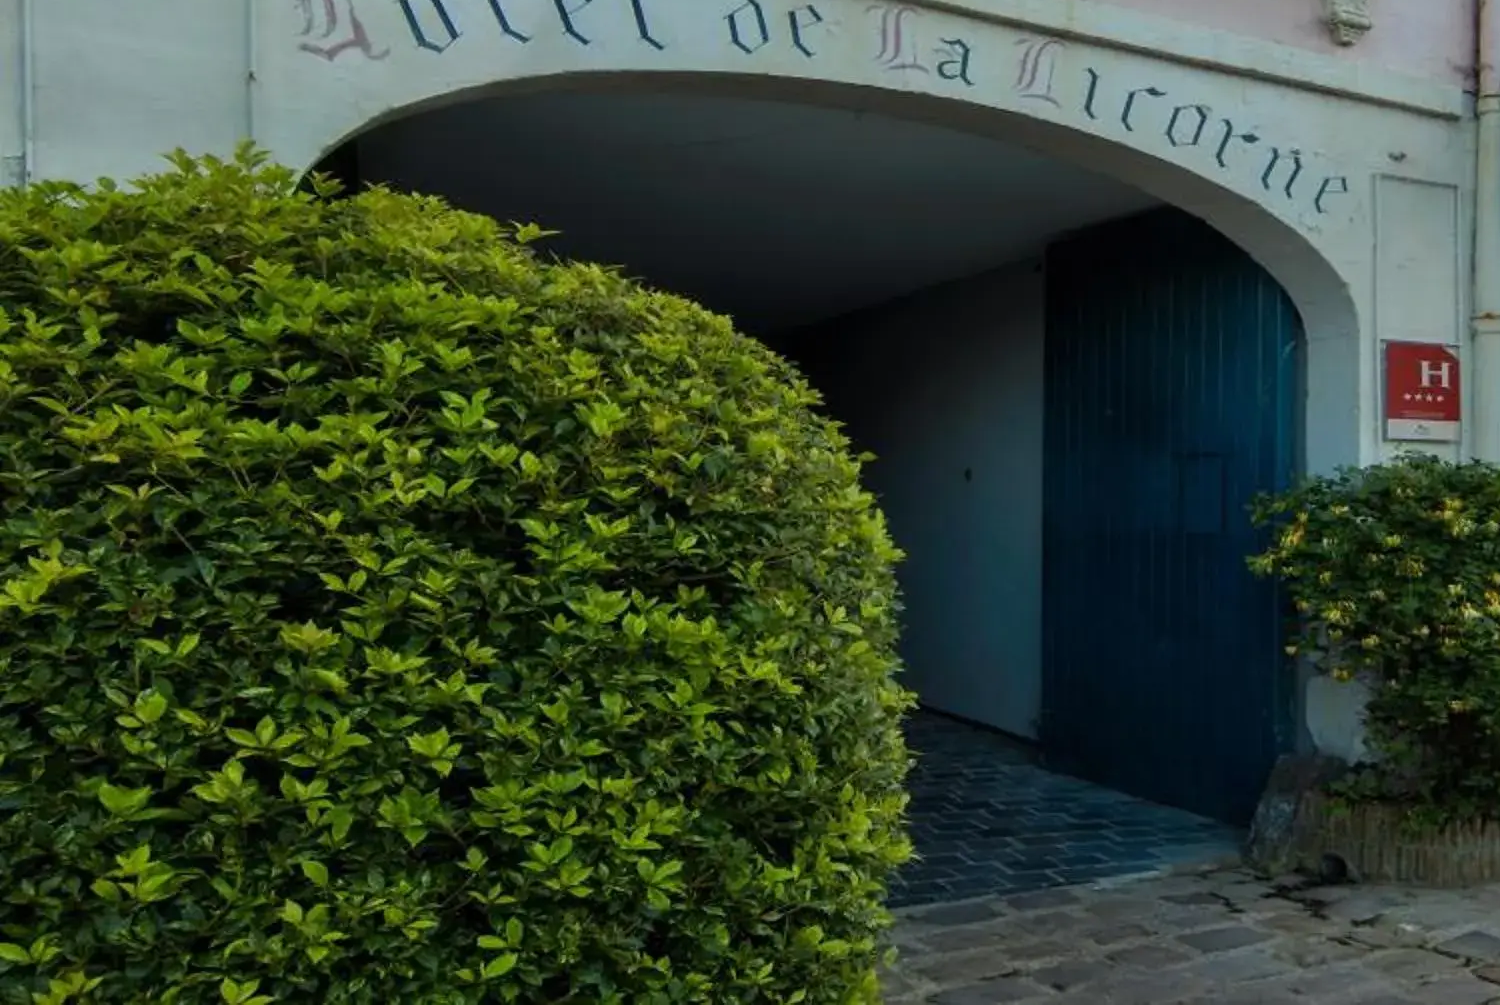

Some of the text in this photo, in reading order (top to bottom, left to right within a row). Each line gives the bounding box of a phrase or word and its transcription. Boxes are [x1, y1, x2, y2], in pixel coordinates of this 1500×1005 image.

[866, 4, 974, 86] La
[1012, 36, 1349, 214] Licorne
[1418, 360, 1452, 388] H
